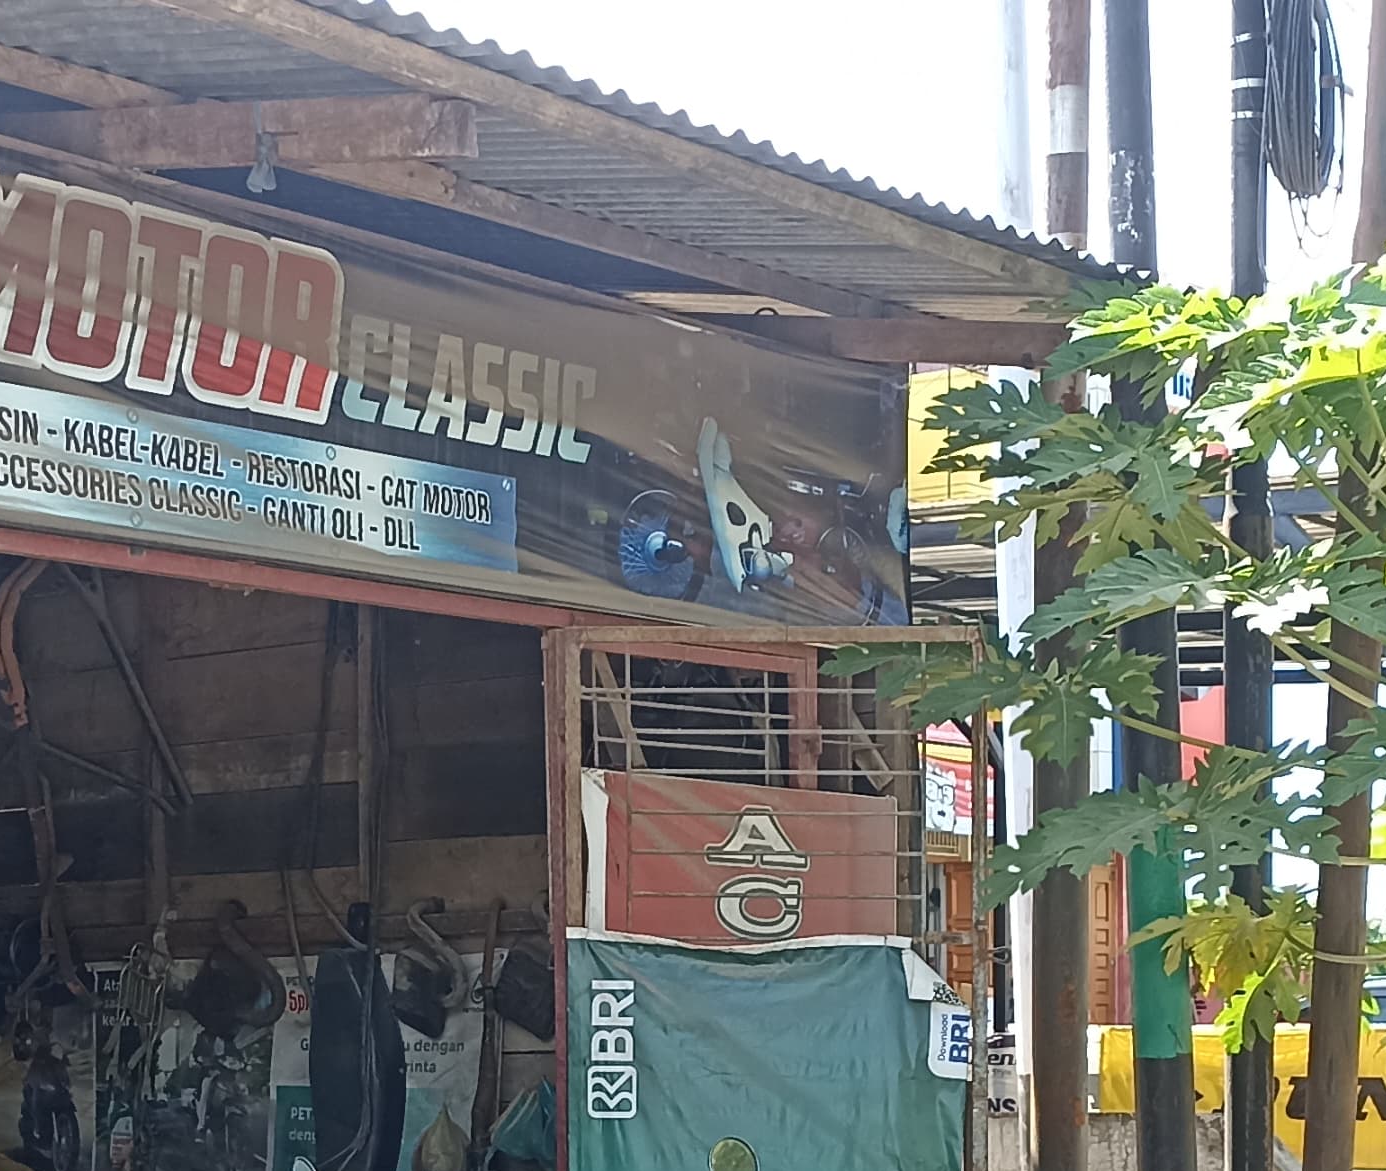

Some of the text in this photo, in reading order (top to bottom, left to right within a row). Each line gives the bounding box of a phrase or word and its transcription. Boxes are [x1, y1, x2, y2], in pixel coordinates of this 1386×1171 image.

[340, 313, 599, 464] CLASSIC
[63, 418, 226, 478] KABEL-KABEL
[246, 450, 362, 500] RESTORASI
[380, 474, 419, 505] CAT
[422, 483, 492, 524] MOTOR
[150, 477, 243, 522] CLASSIC
[261, 497, 328, 537] GANTI
[331, 508, 365, 542] OLI
[383, 515, 421, 551] DLL
[414, 1039, 465, 1055] dengan
[592, 979, 635, 1064] BRI
[290, 1107, 313, 1121] PET
